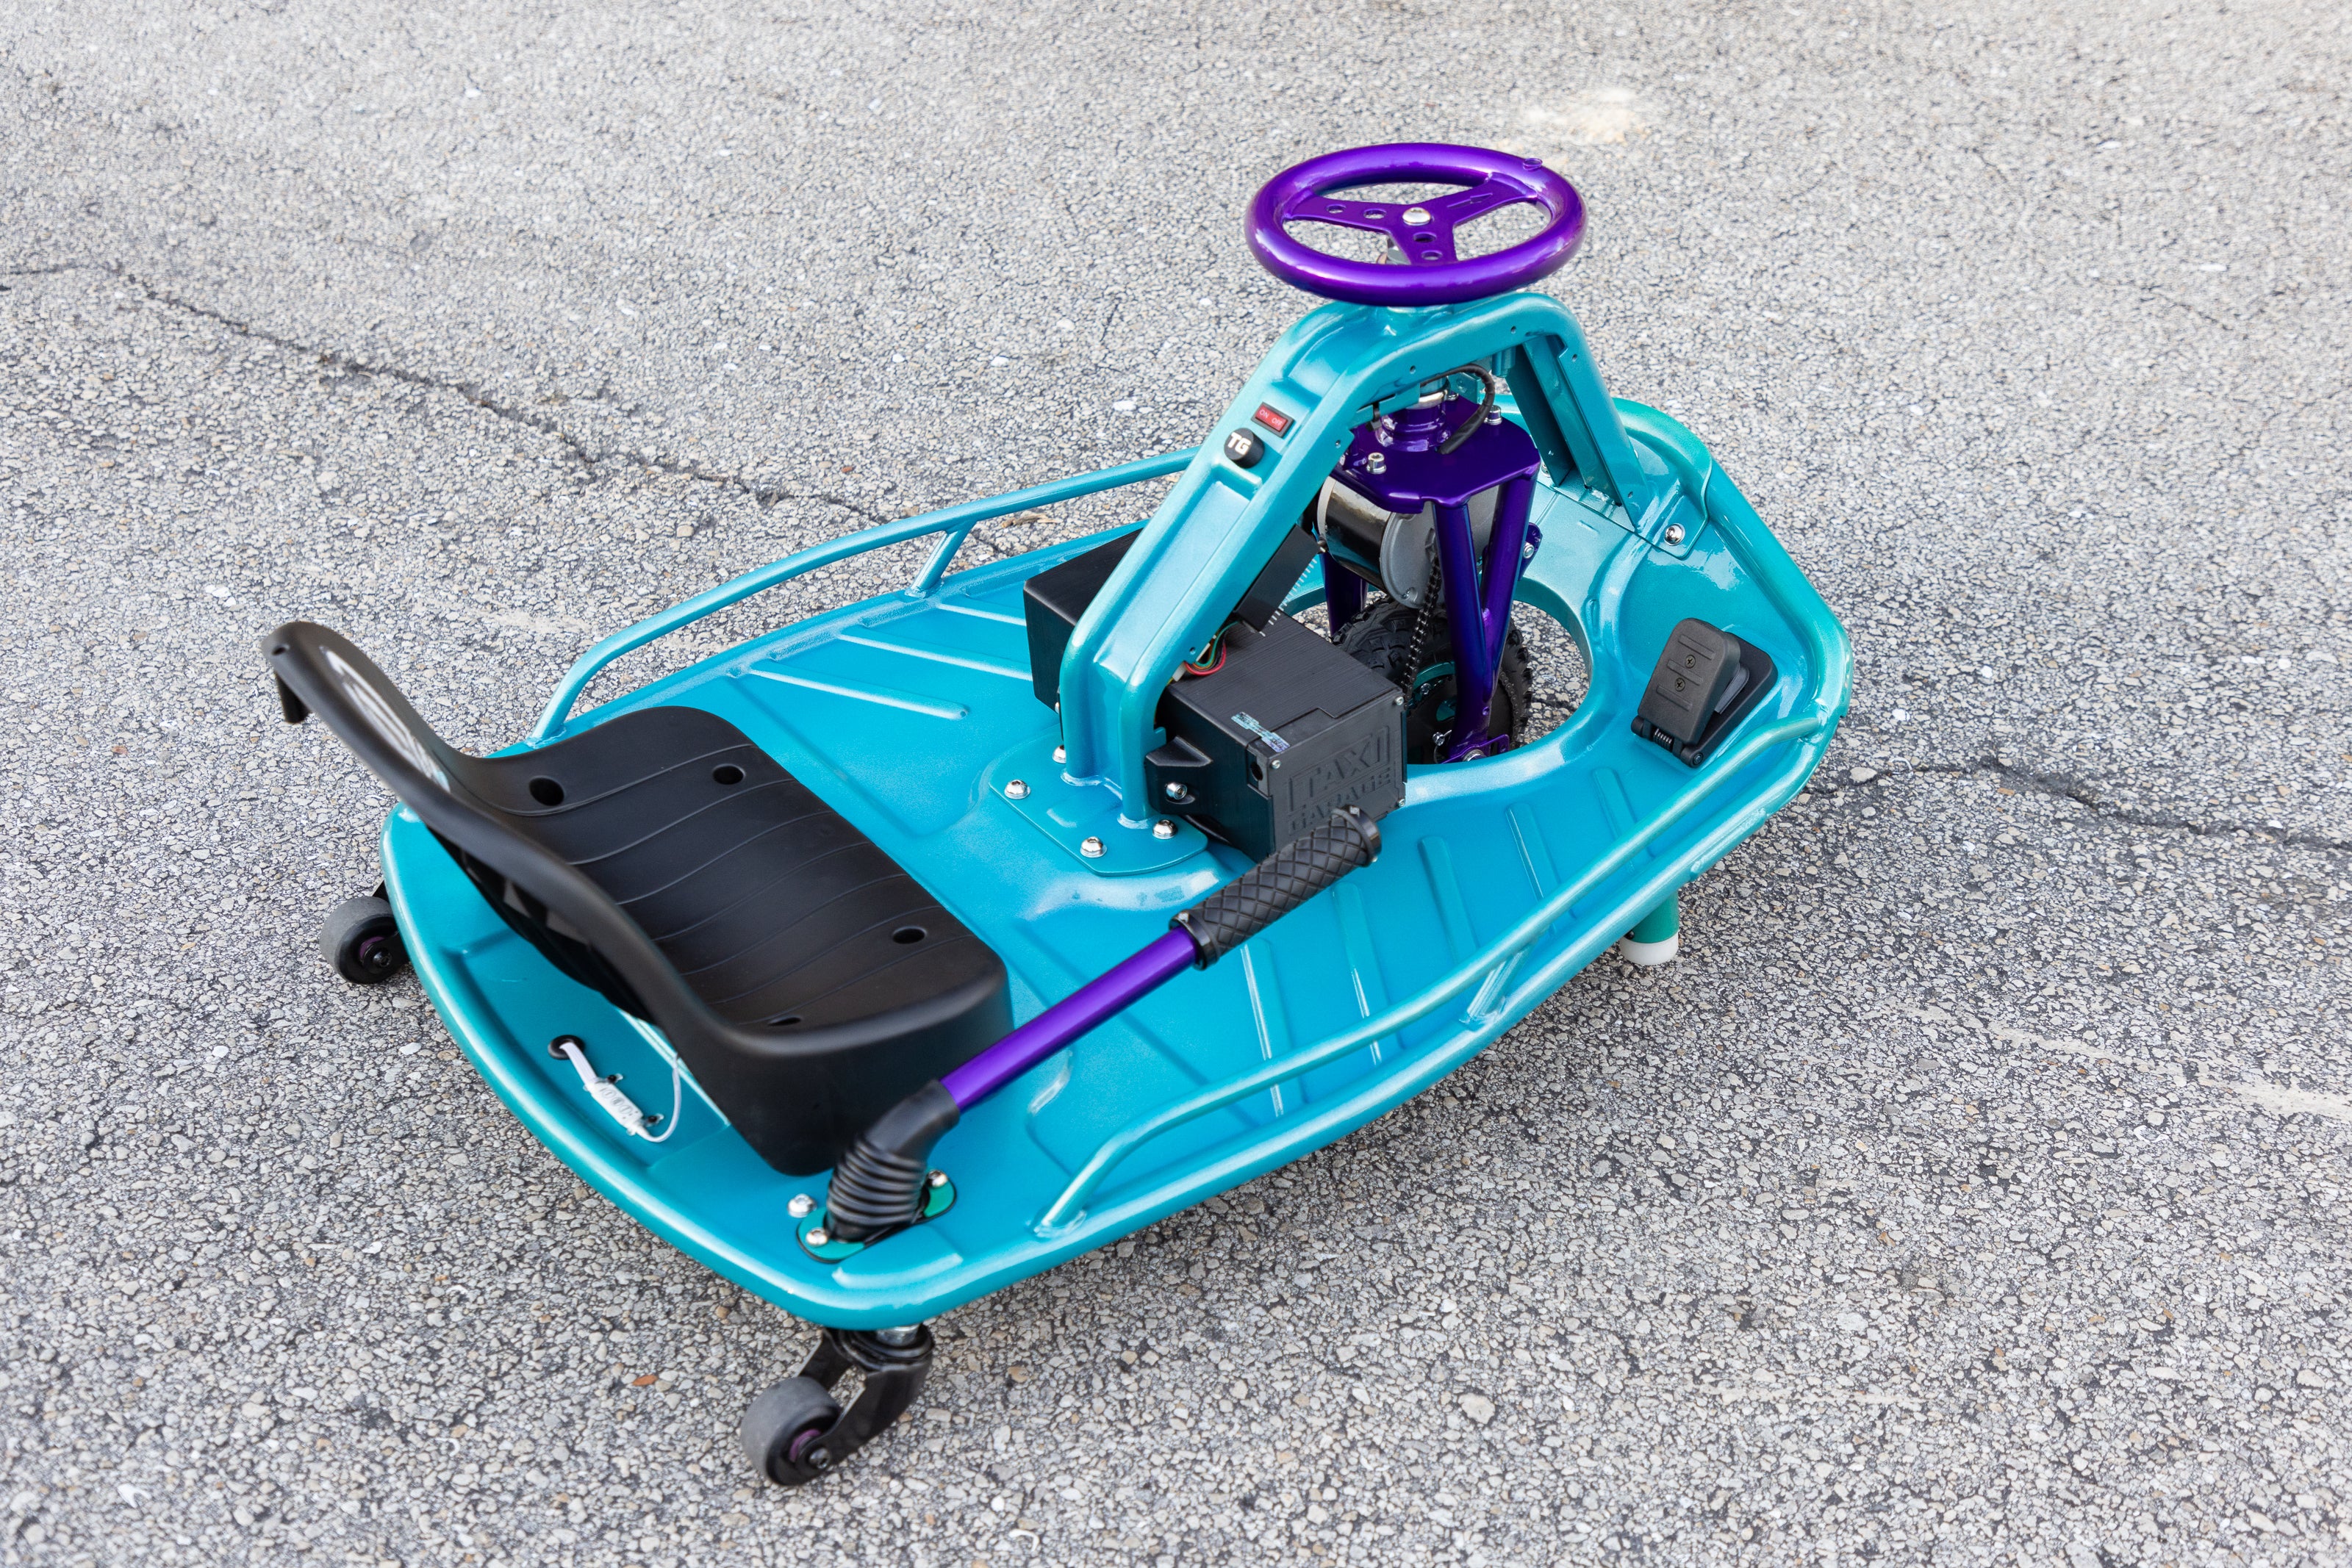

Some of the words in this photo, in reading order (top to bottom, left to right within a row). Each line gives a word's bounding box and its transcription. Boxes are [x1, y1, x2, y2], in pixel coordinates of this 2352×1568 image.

[1260, 409, 1269, 419] ON
[1272, 417, 1283, 426] OFF
[1227, 432, 1252, 455] TG
[1292, 733, 1380, 799] TAXI
